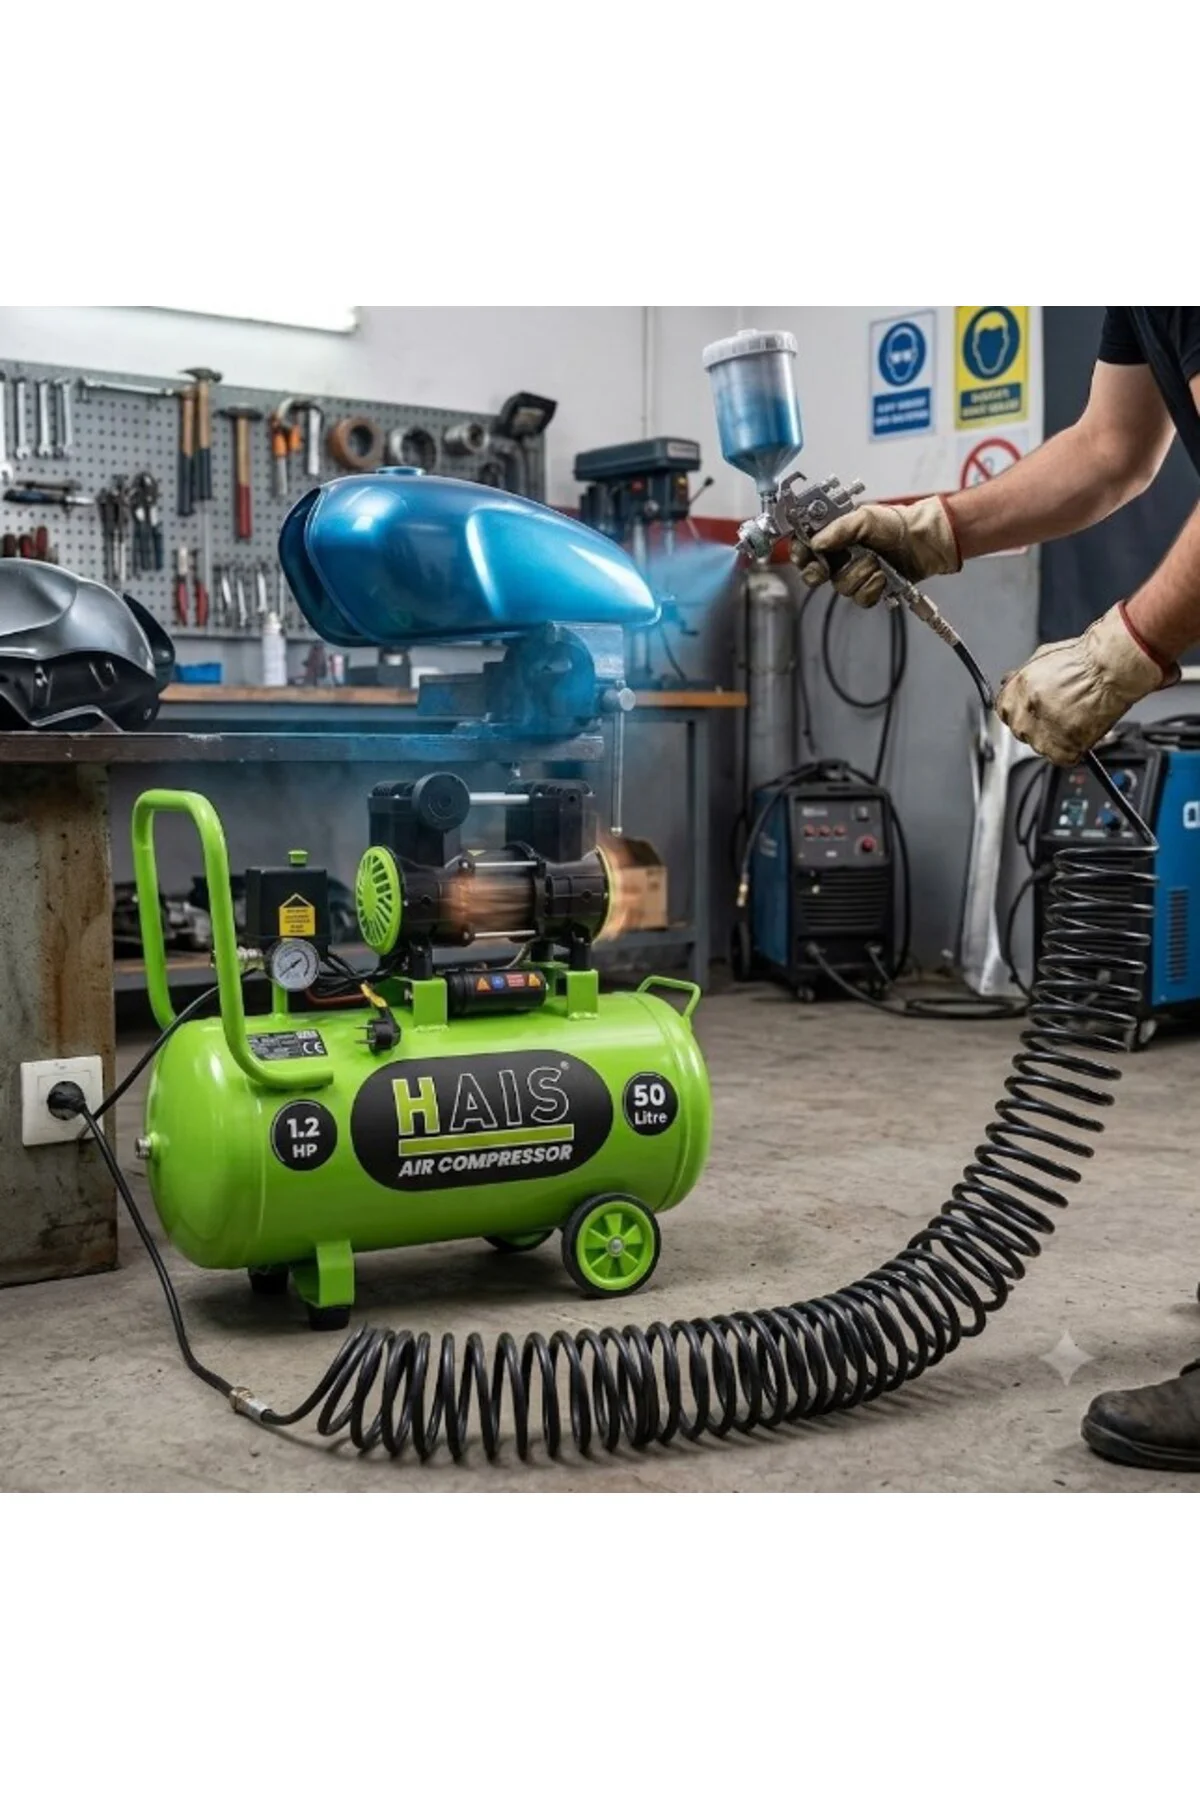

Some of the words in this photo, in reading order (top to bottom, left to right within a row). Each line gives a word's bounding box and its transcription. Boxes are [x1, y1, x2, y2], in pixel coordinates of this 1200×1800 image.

[392, 1067, 570, 1135] HAIS
[634, 1083, 666, 1107] 50
[286, 1116, 320, 1138] 1.2
[634, 1110, 668, 1125] Litre
[292, 1143, 318, 1158] HP
[399, 1159, 433, 1177] AIR
[438, 1144, 573, 1173] COMPRESSOR
